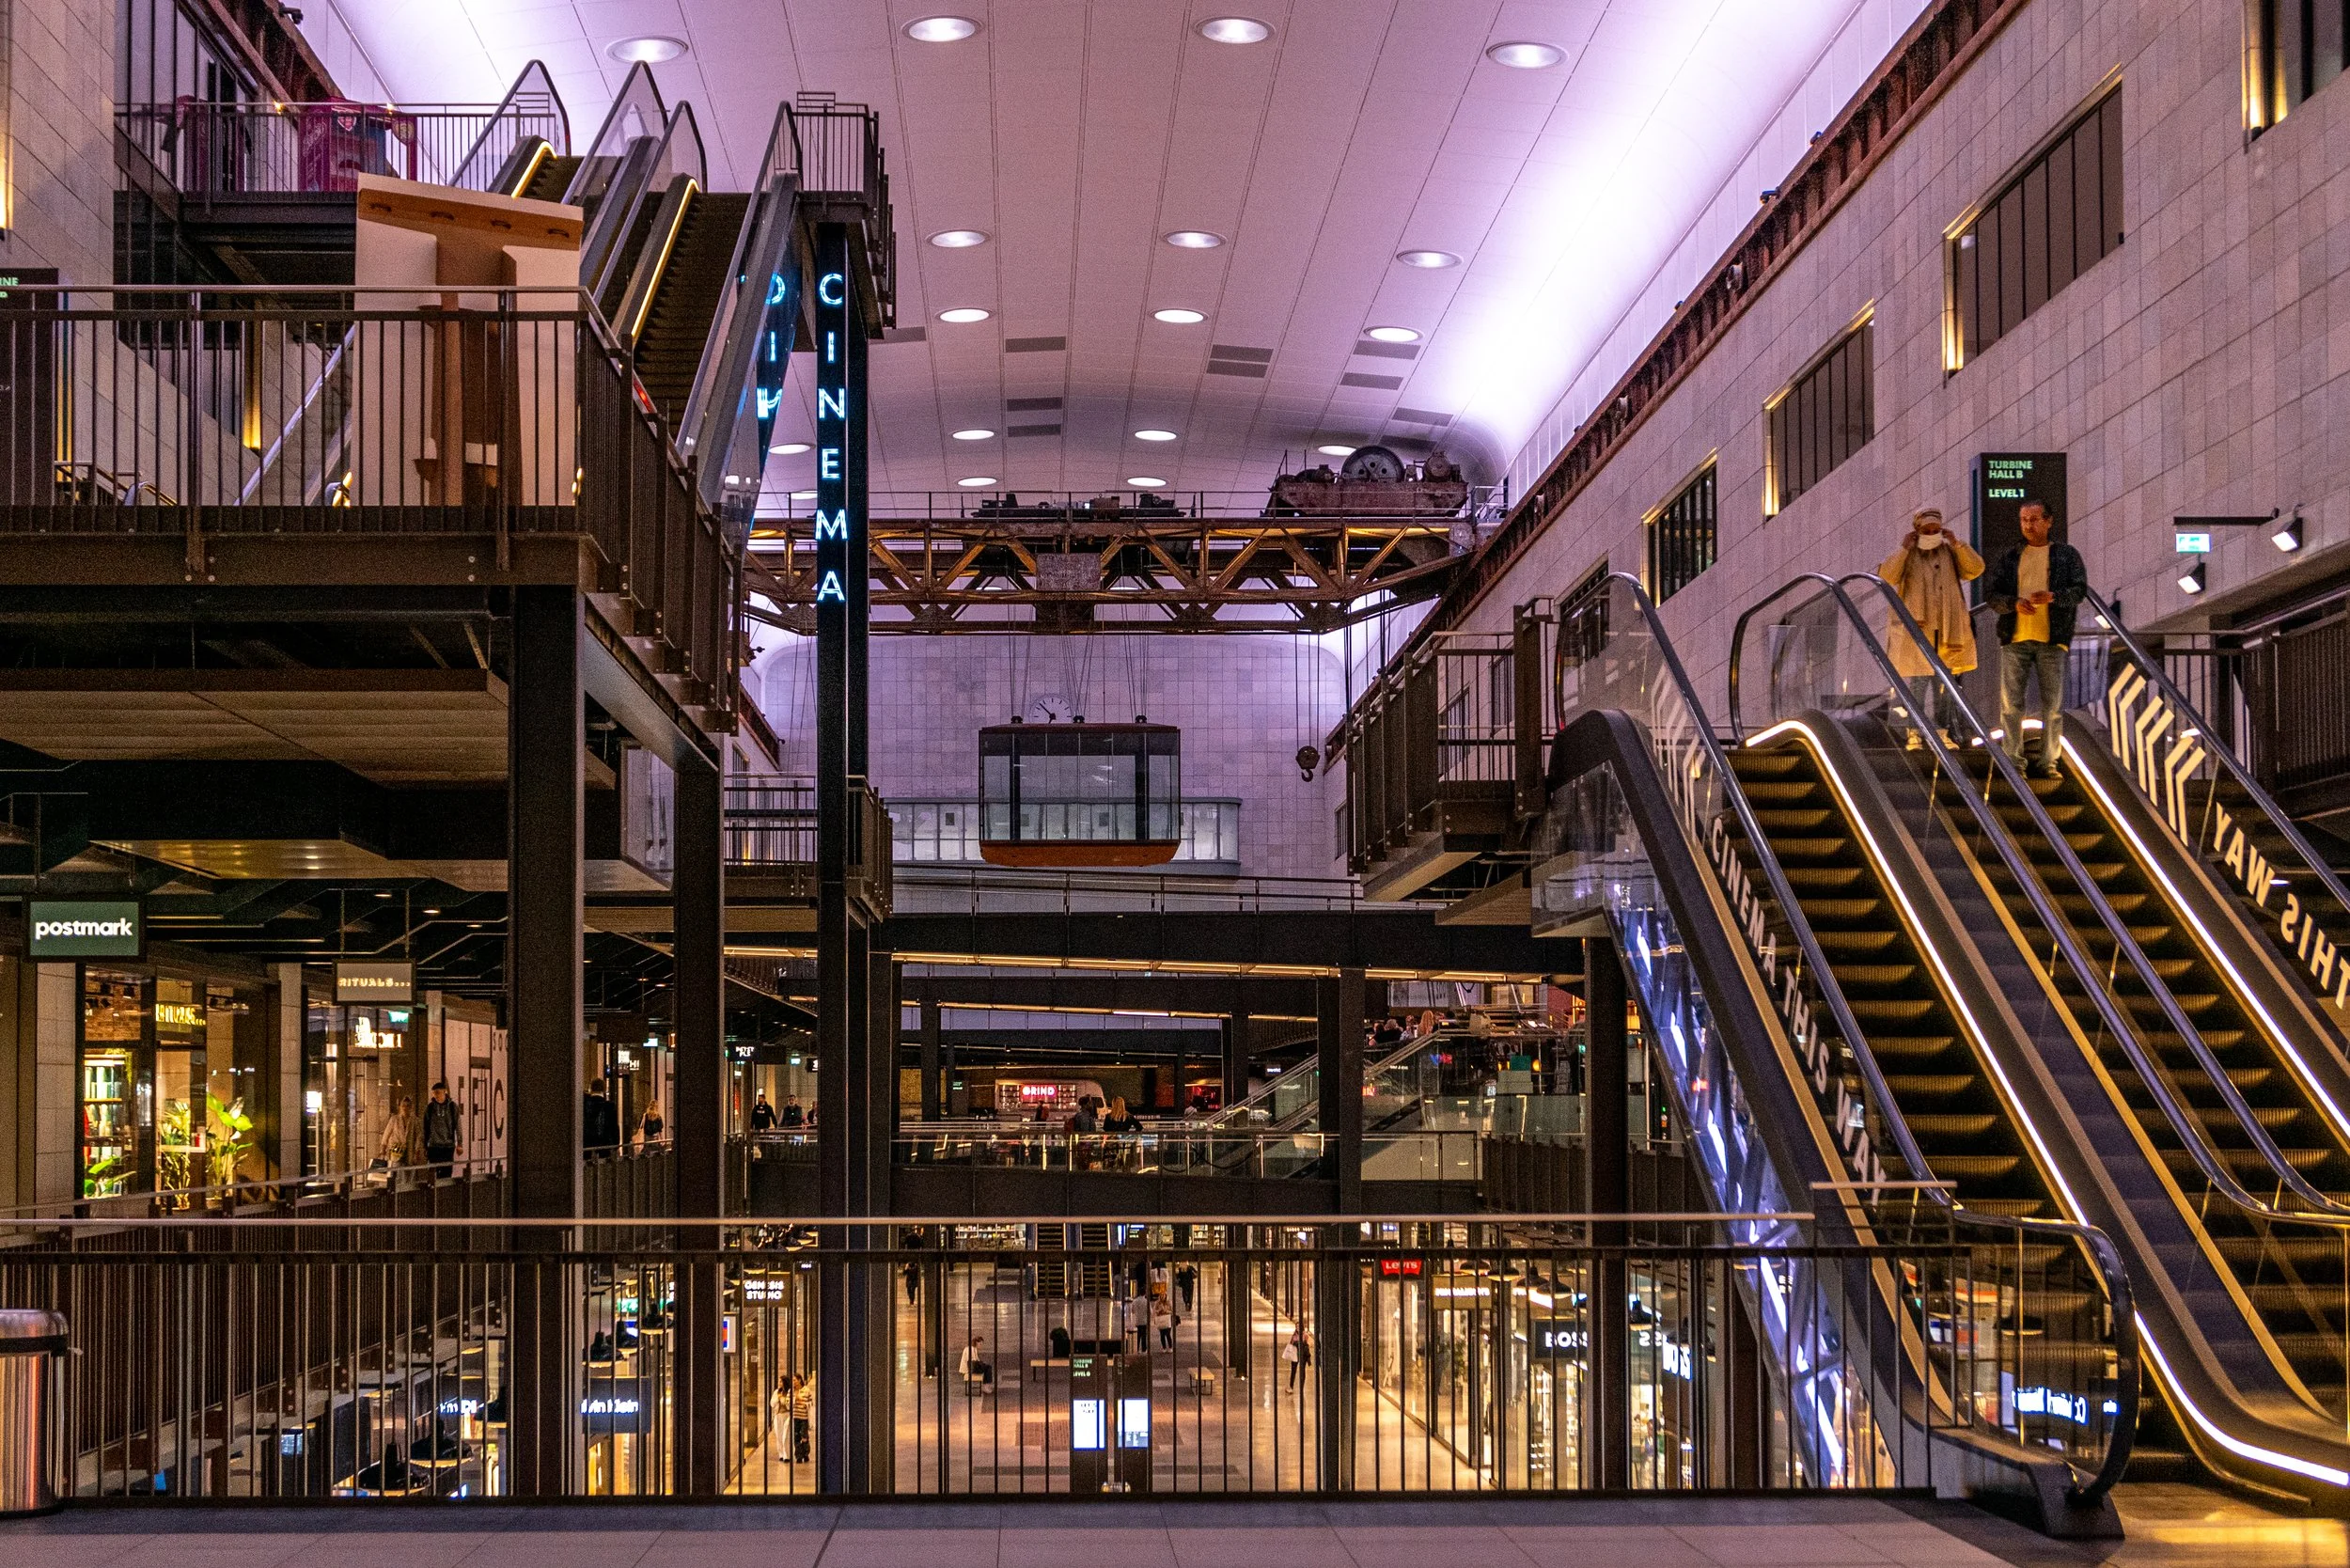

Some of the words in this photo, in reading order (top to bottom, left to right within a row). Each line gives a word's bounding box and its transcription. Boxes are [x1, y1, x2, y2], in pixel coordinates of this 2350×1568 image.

[815, 273, 848, 602] CINEMA
[1988, 460, 2032, 469] TURBINE
[1988, 470, 2015, 478] HALL
[2016, 470, 2024, 478] B
[1988, 489, 2018, 497] LEVEL
[2018, 489, 2025, 497] 1
[35, 917, 133, 940] postmark
[1712, 817, 1777, 985] CINEMA
[1783, 964, 1829, 1094] THIS
[1836, 1077, 1888, 1213] WAY
[1022, 1086, 1055, 1096] GRIND
